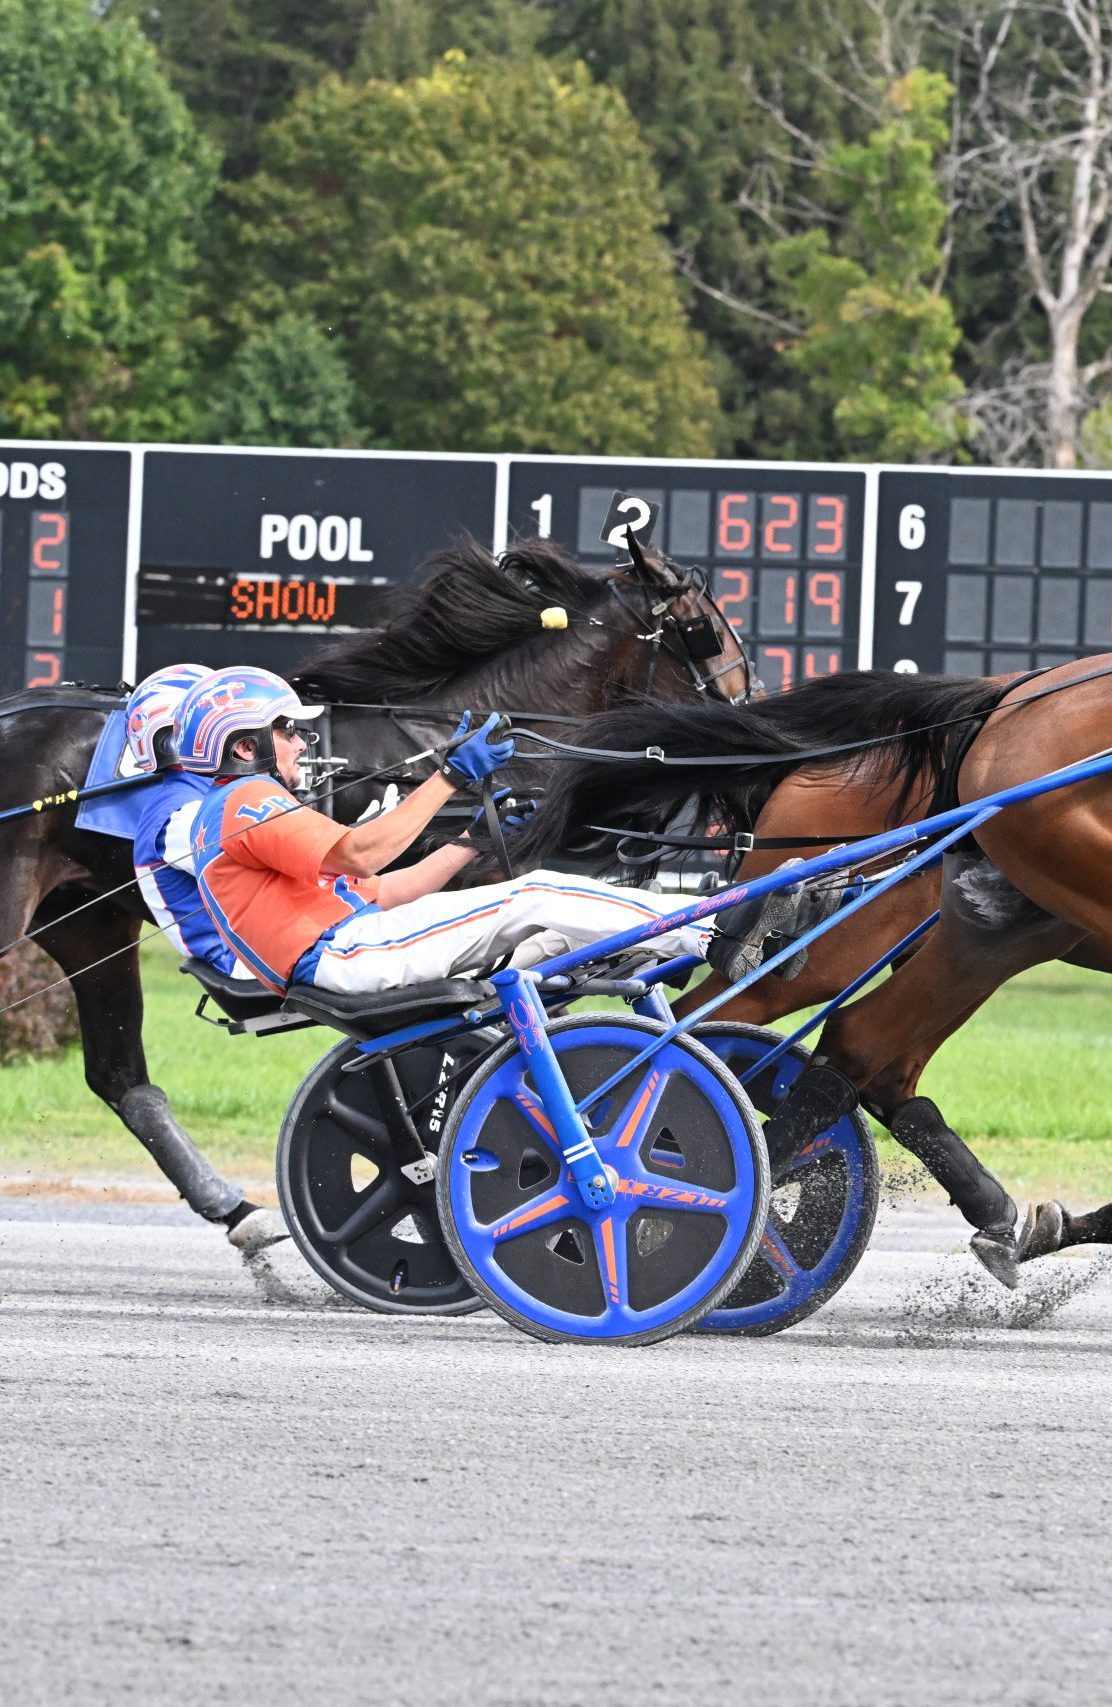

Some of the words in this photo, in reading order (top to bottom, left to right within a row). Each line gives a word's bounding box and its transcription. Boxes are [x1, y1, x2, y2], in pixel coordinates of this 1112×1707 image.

[33, 513, 66, 569] 2
[260, 514, 373, 561] POOL
[531, 493, 552, 538] 1
[718, 494, 844, 554] 623
[608, 498, 651, 549] 2
[898, 504, 926, 549] 6
[53, 589, 63, 635] 1
[231, 580, 336, 621] SHOW
[716, 570, 841, 627] 219
[895, 581, 922, 625] 7
[642, 1183, 707, 1206] LZR
